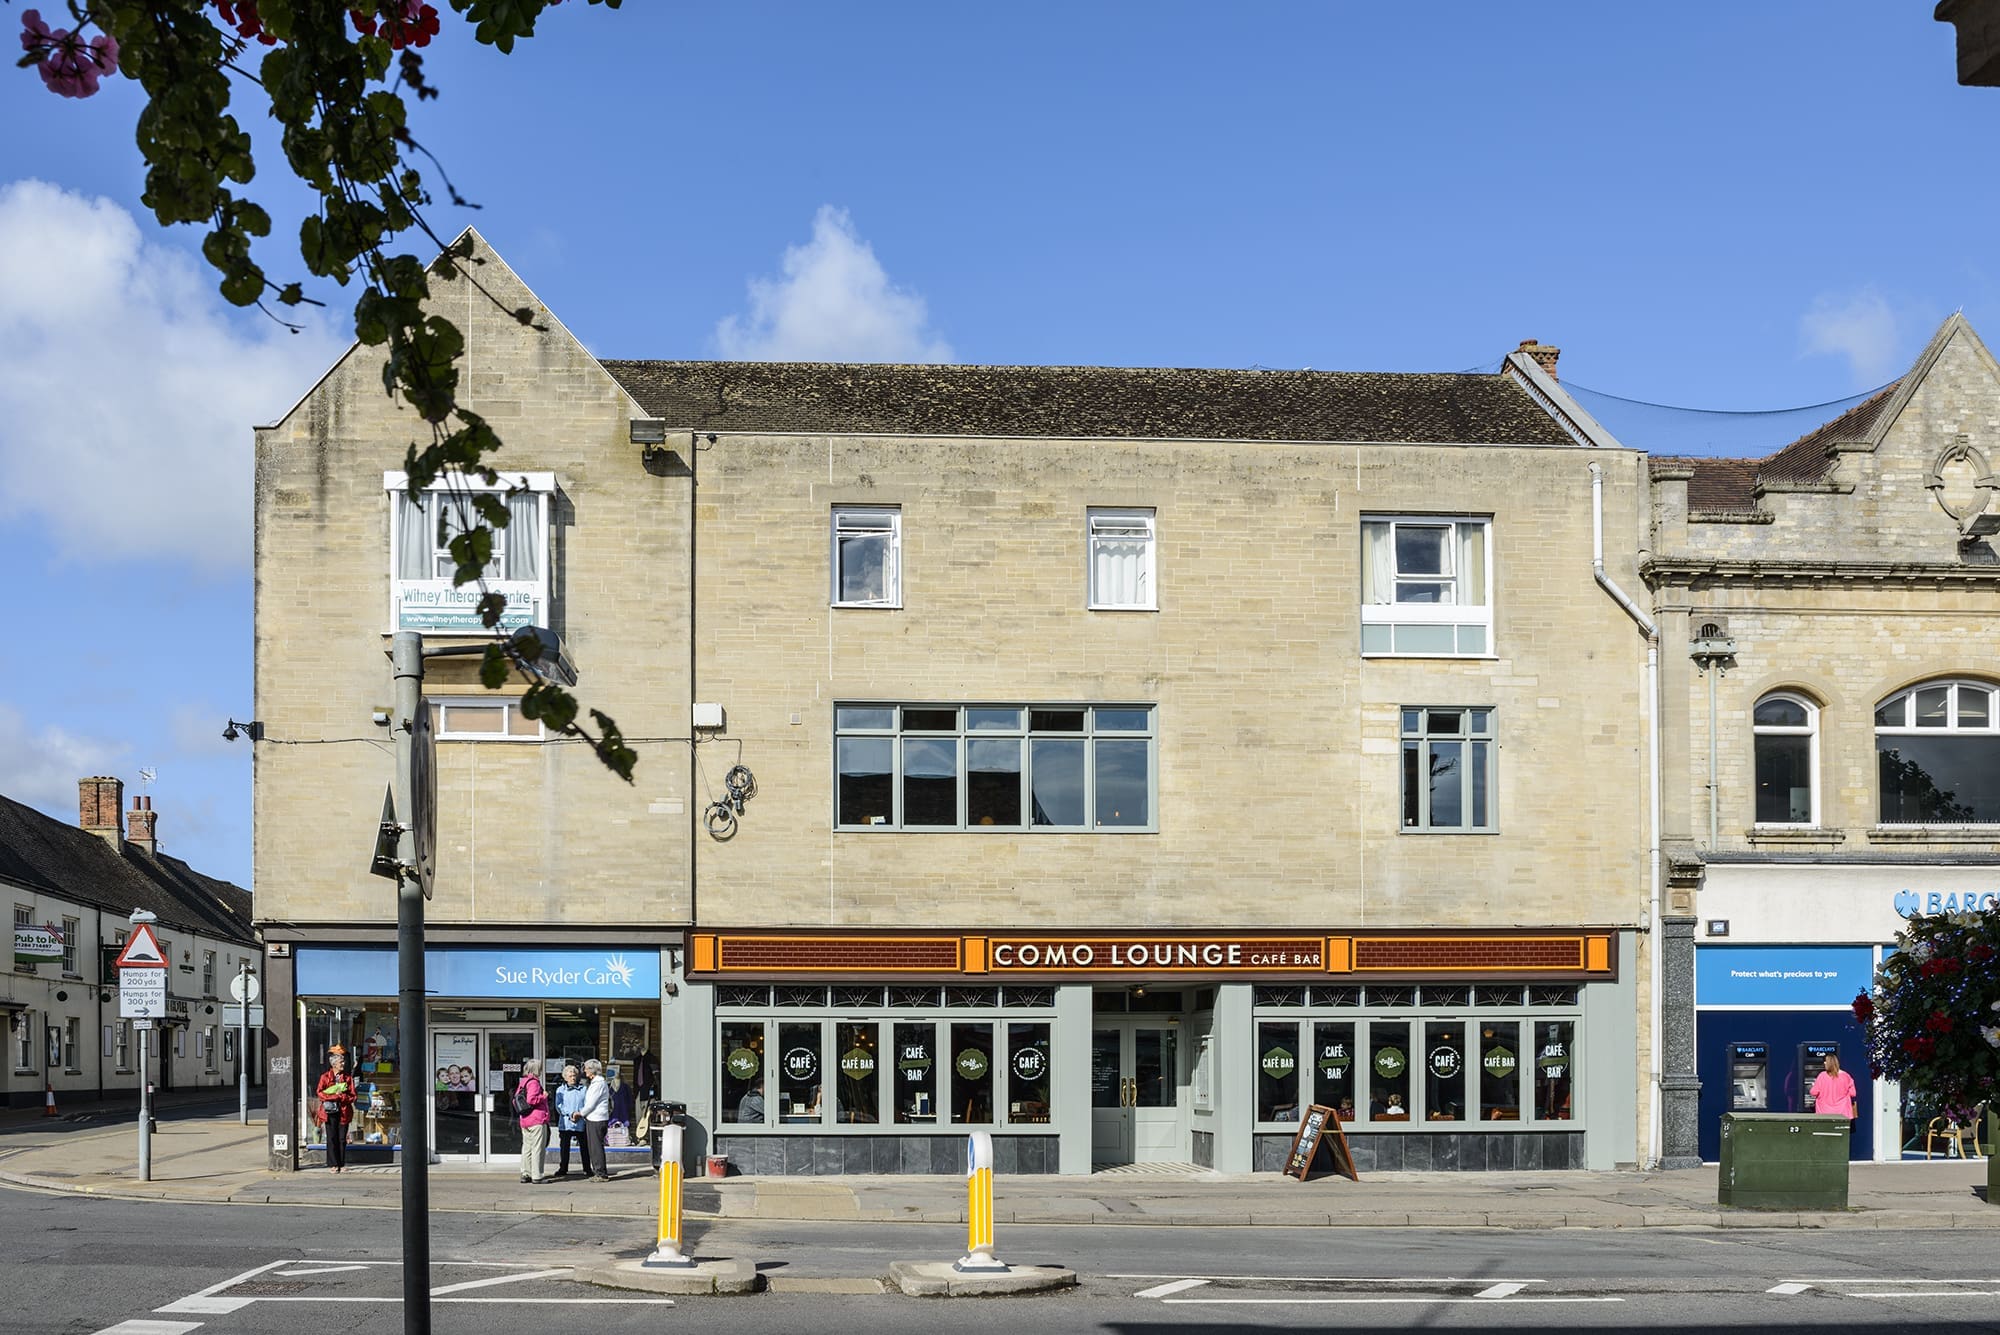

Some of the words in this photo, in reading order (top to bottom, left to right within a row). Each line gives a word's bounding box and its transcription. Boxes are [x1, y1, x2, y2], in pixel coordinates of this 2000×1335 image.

[403, 589, 441, 605] Witney
[444, 589, 484, 605] Therap
[494, 589, 530, 604] entre
[1926, 892, 2000, 915] BARC
[15, 934, 34, 943] Pub
[36, 935, 47, 943] to
[48, 935, 61, 944] le
[995, 944, 1094, 965] COMO
[1112, 944, 1241, 965] LOUNGE
[1251, 952, 1286, 964] CAFÉ
[1294, 954, 1320, 965] BAR
[495, 966, 528, 984] Sue
[532, 968, 581, 986] Ryder
[583, 967, 621, 985] Care
[1731, 970, 1757, 978] Protect
[1758, 970, 1782, 978] what's
[1783, 970, 1813, 979] precious
[1814, 970, 1822, 978] to
[1823, 971, 1837, 979] you
[906, 1045, 924, 1059] CAFÉ
[1325, 1044, 1343, 1057] CAFÉ
[1545, 1043, 1563, 1056] CAFÉ
[790, 1054, 811, 1069] CAFÉ
[841, 1057, 858, 1069] CAFÉ
[860, 1059, 874, 1069] BAR
[1019, 1054, 1039, 1069] CAFÉ
[1262, 1056, 1279, 1068] CAFÉ
[1280, 1058, 1294, 1068] BAR
[1435, 1053, 1455, 1067] CAFÉ
[1484, 1055, 1500, 1067] CAFÉ
[1502, 1057, 1515, 1067] BAR
[907, 1069, 922, 1080] BAR
[1327, 1068, 1342, 1079] BAR
[1546, 1066, 1562, 1078] BAR
